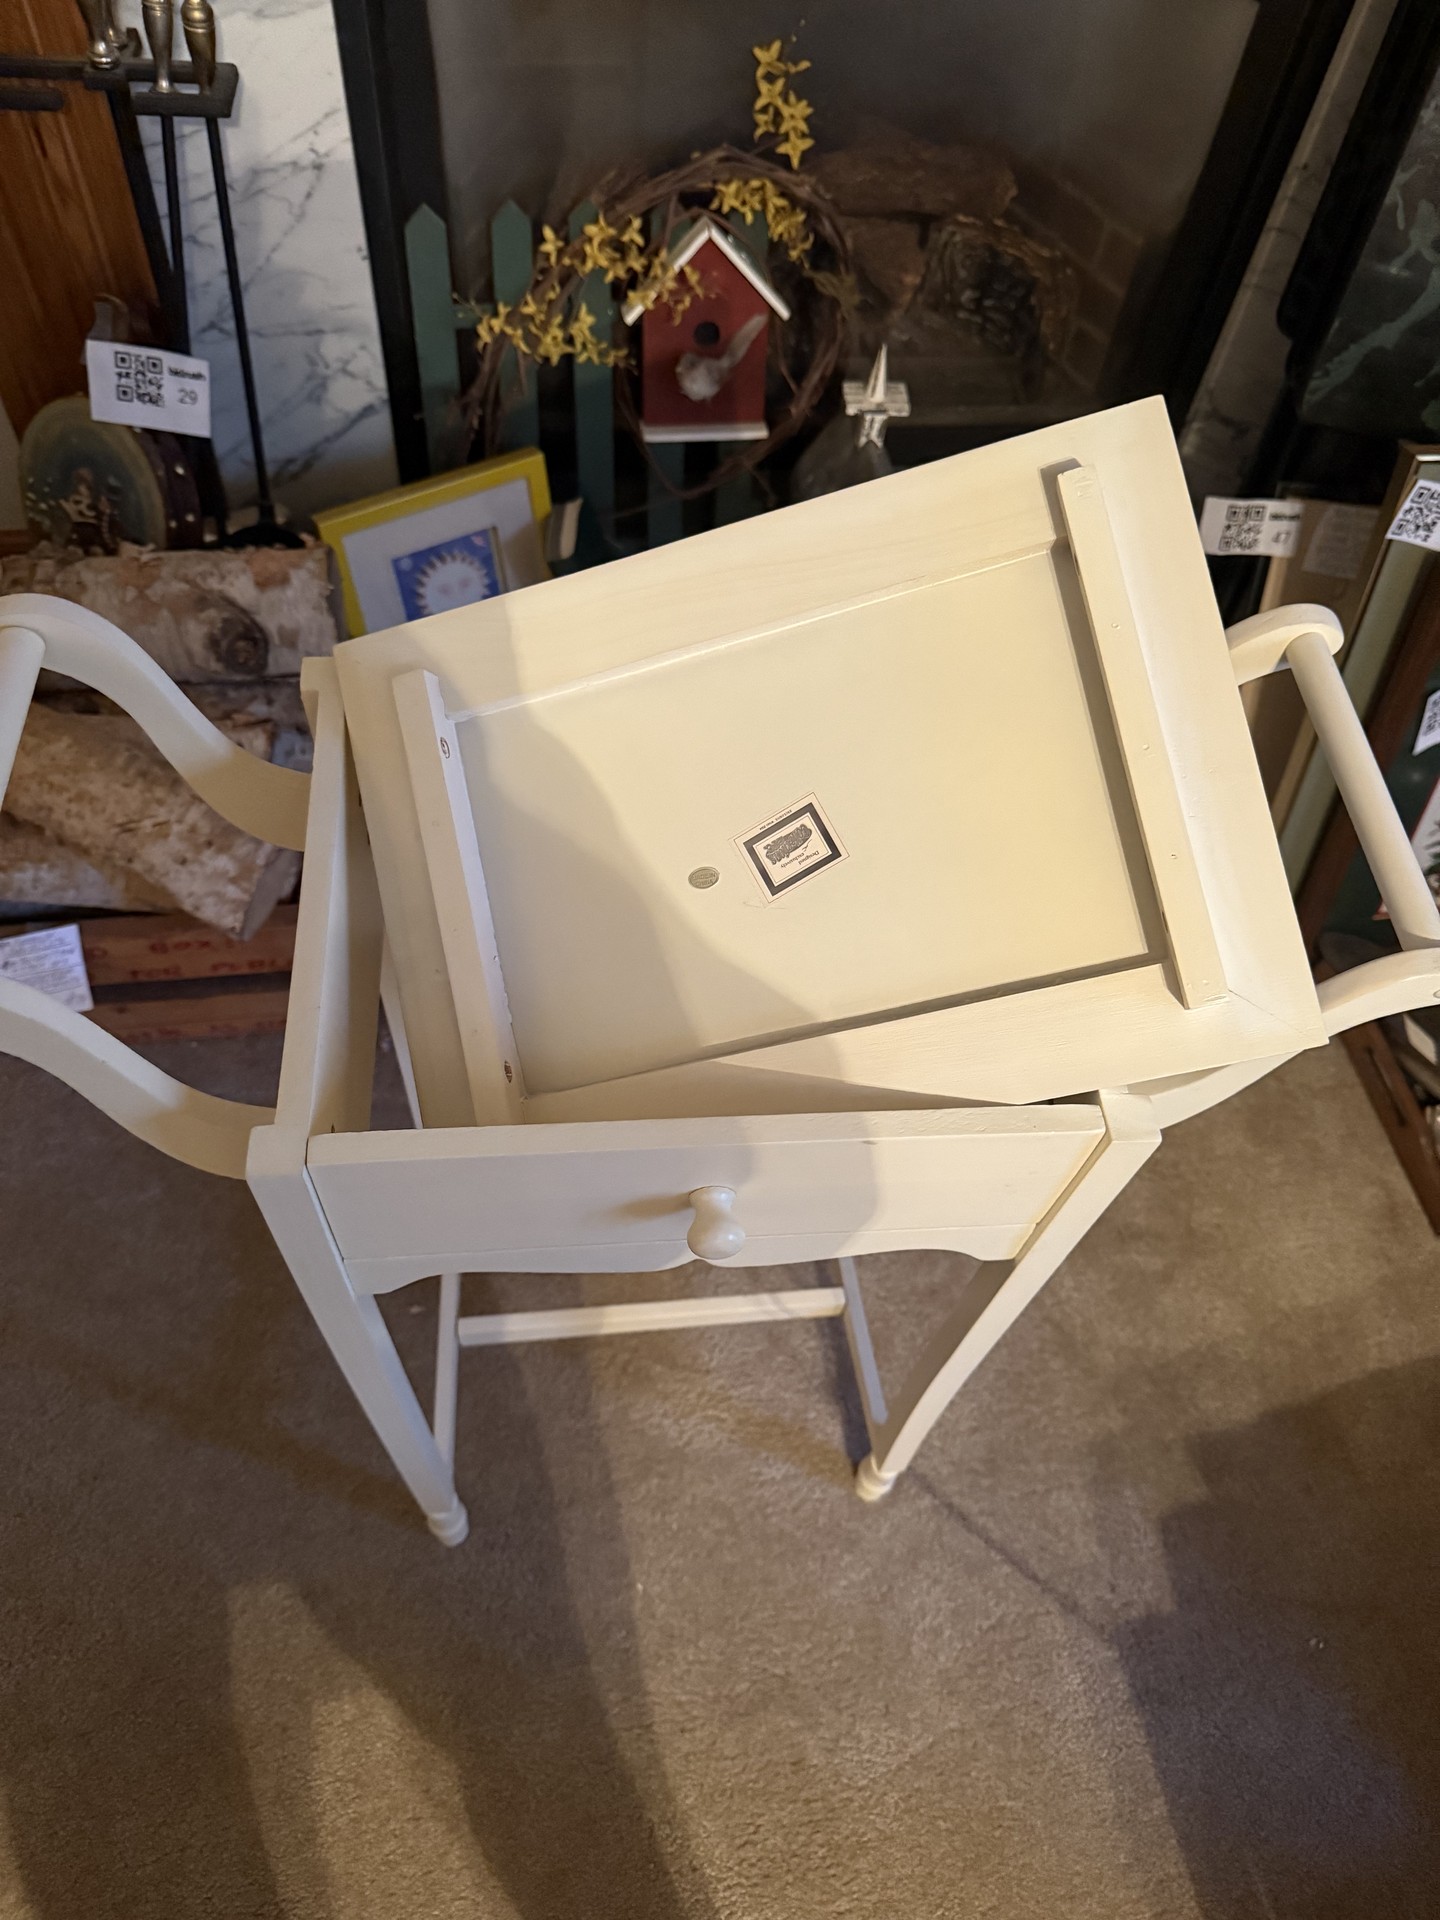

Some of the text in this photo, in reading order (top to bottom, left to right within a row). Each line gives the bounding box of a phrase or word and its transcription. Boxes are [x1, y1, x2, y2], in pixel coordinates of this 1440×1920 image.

[178, 388, 198, 406] 29
[780, 852, 805, 868] exclusively
[798, 850, 820, 865] Designed
